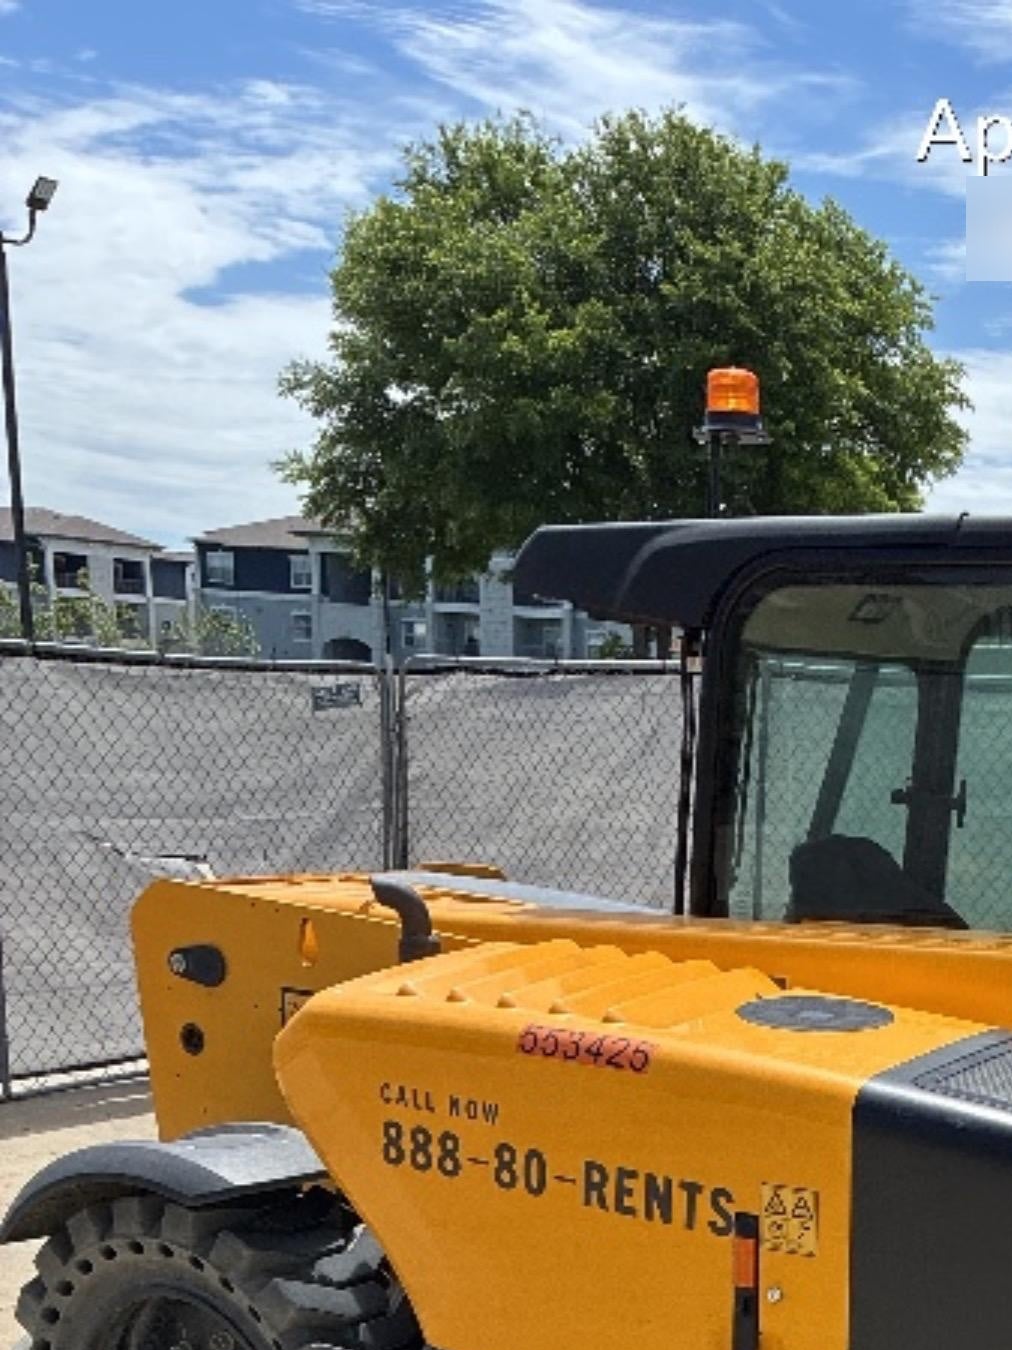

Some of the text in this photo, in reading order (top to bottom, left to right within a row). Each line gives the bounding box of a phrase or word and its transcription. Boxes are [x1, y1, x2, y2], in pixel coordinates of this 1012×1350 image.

[380, 1082, 499, 1126] CALL NOW
[383, 1120, 737, 1237] 888-80-RENTS
